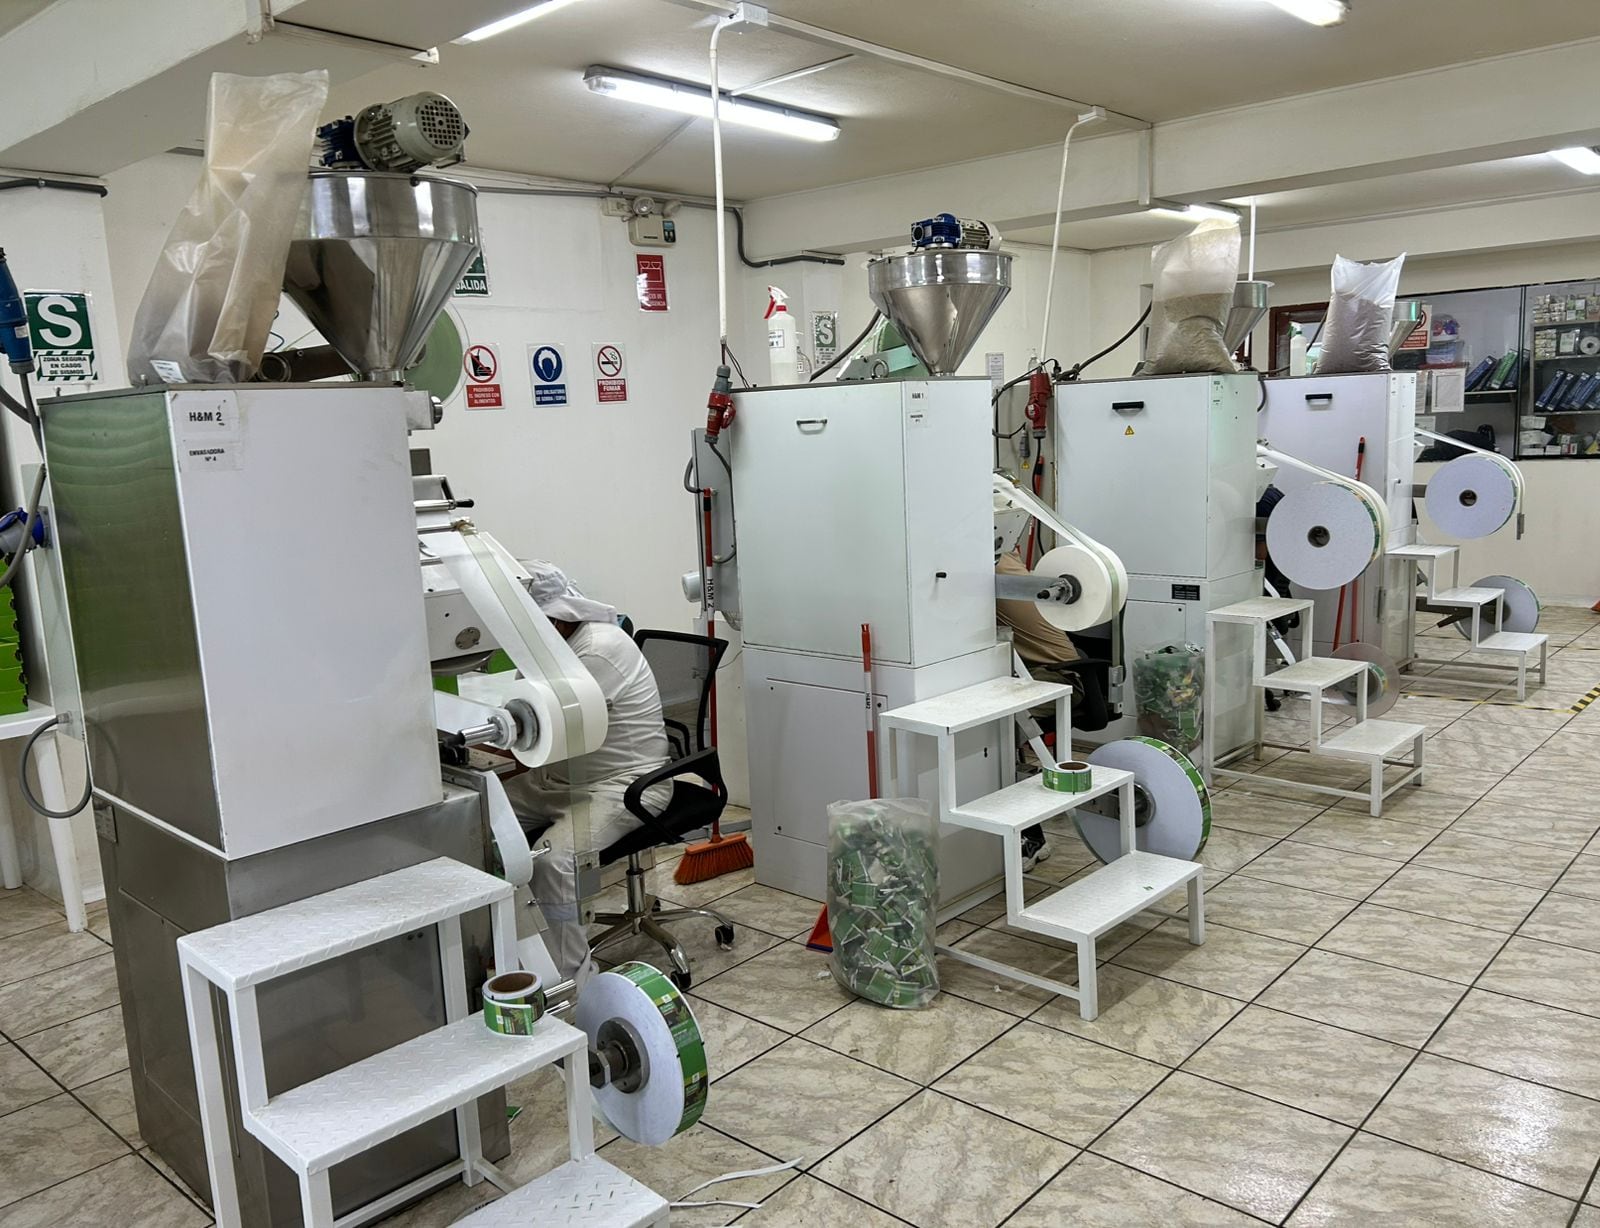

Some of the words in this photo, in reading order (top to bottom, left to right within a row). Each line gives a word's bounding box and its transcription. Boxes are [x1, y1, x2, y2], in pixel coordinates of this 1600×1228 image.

[38, 296, 82, 347] S
[819, 319, 833, 345] S
[189, 412, 213, 421] H&M
[216, 412, 223, 421] 2
[189, 448, 225, 456] ENVASADORA
